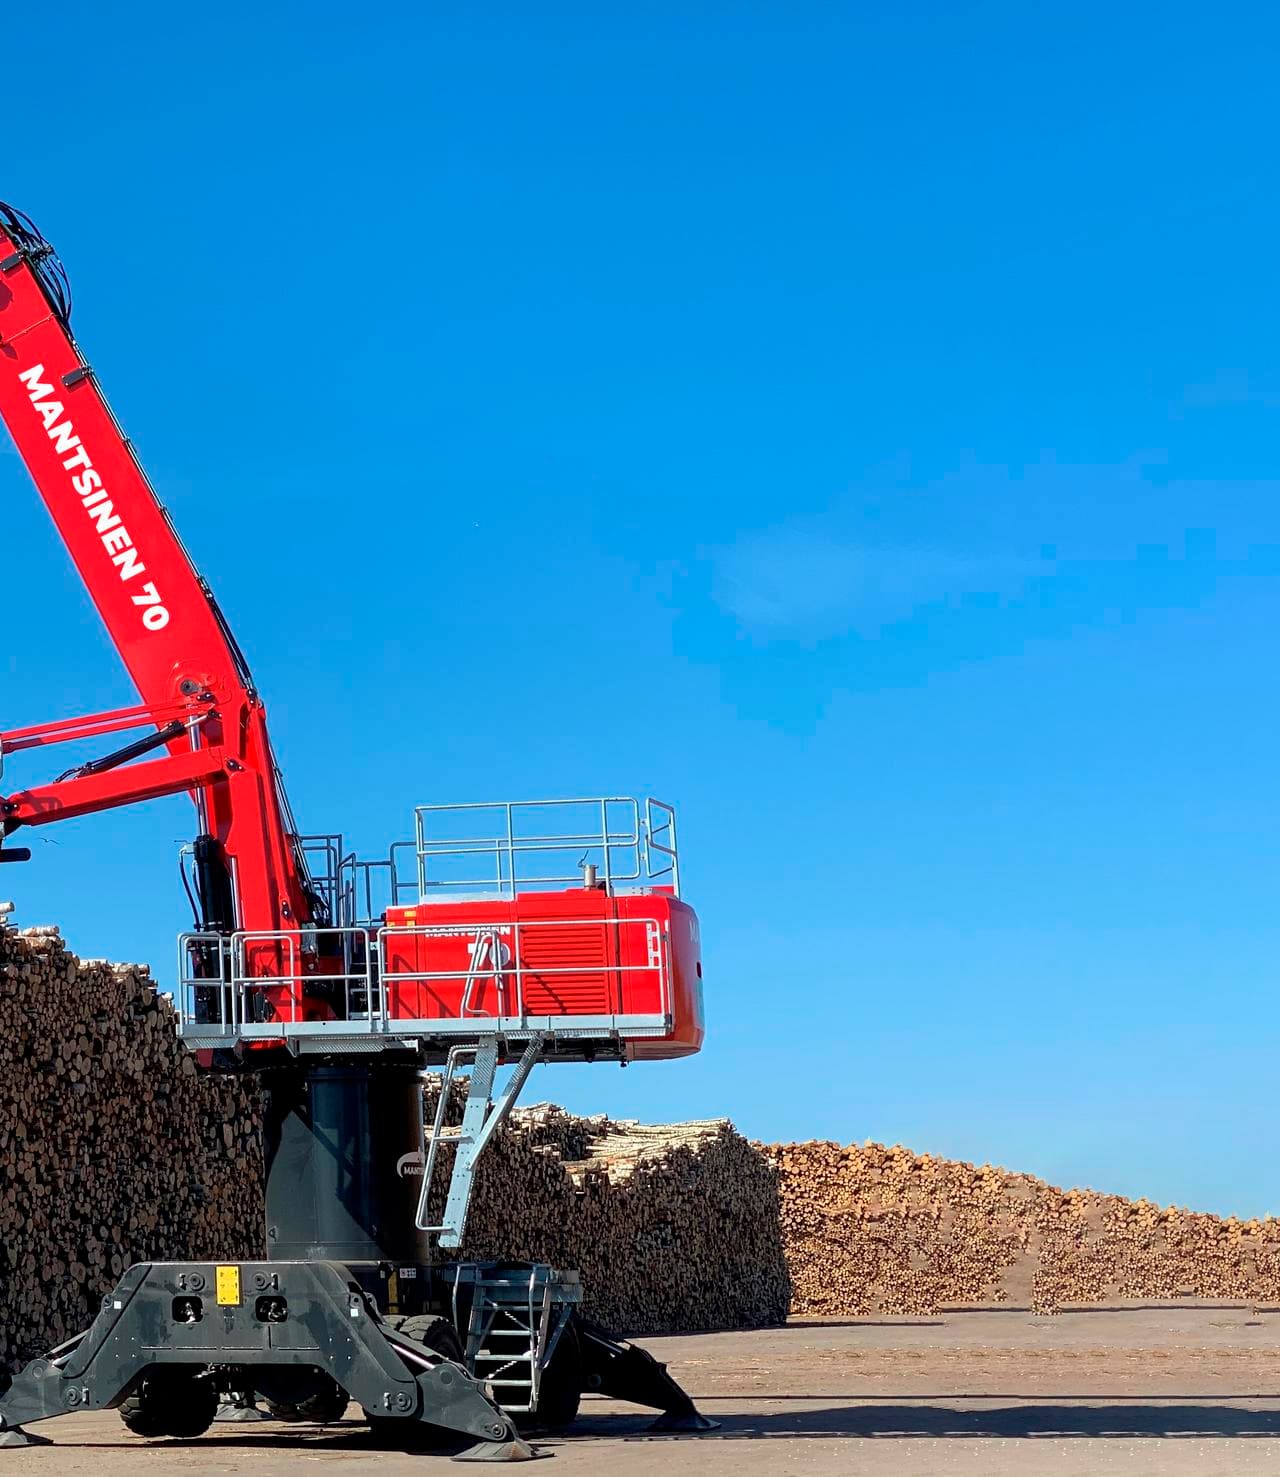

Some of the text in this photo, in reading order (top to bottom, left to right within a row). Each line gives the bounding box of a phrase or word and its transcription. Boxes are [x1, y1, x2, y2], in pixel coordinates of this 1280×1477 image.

[18, 363, 170, 631] MANTSINEN 70
[425, 926, 510, 937] MANTSNEN
